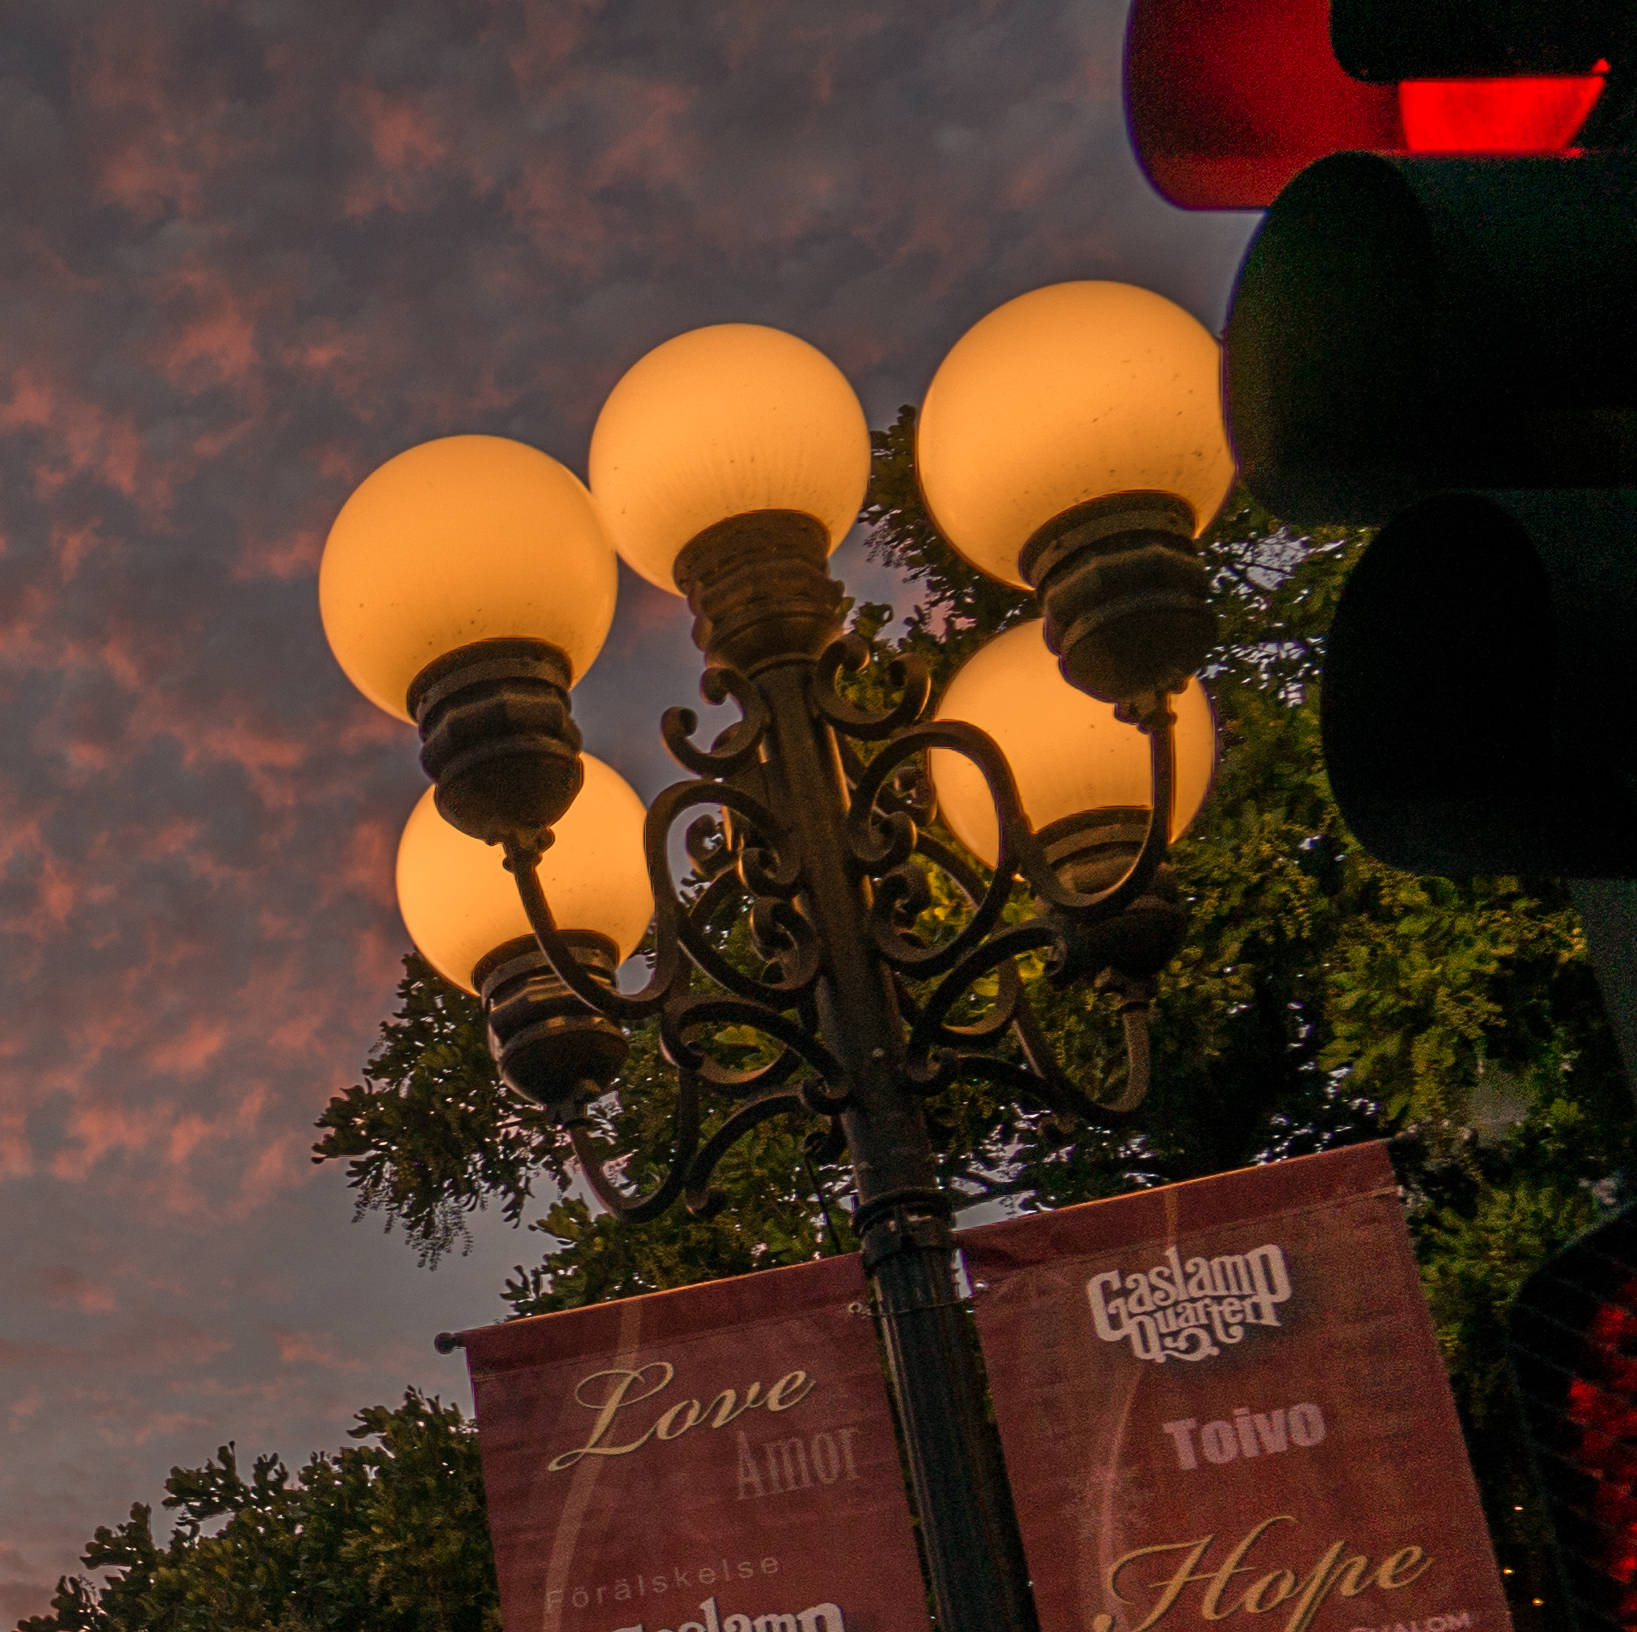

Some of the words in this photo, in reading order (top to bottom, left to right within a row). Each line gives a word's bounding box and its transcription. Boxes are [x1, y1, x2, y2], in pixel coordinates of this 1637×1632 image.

[1086, 1244, 1292, 1342] Gaslamp
[1128, 1299, 1282, 1363] Quarter
[547, 1361, 816, 1472] Love
[1163, 1402, 1327, 1470] Toivo
[735, 1426, 860, 1502] Amor
